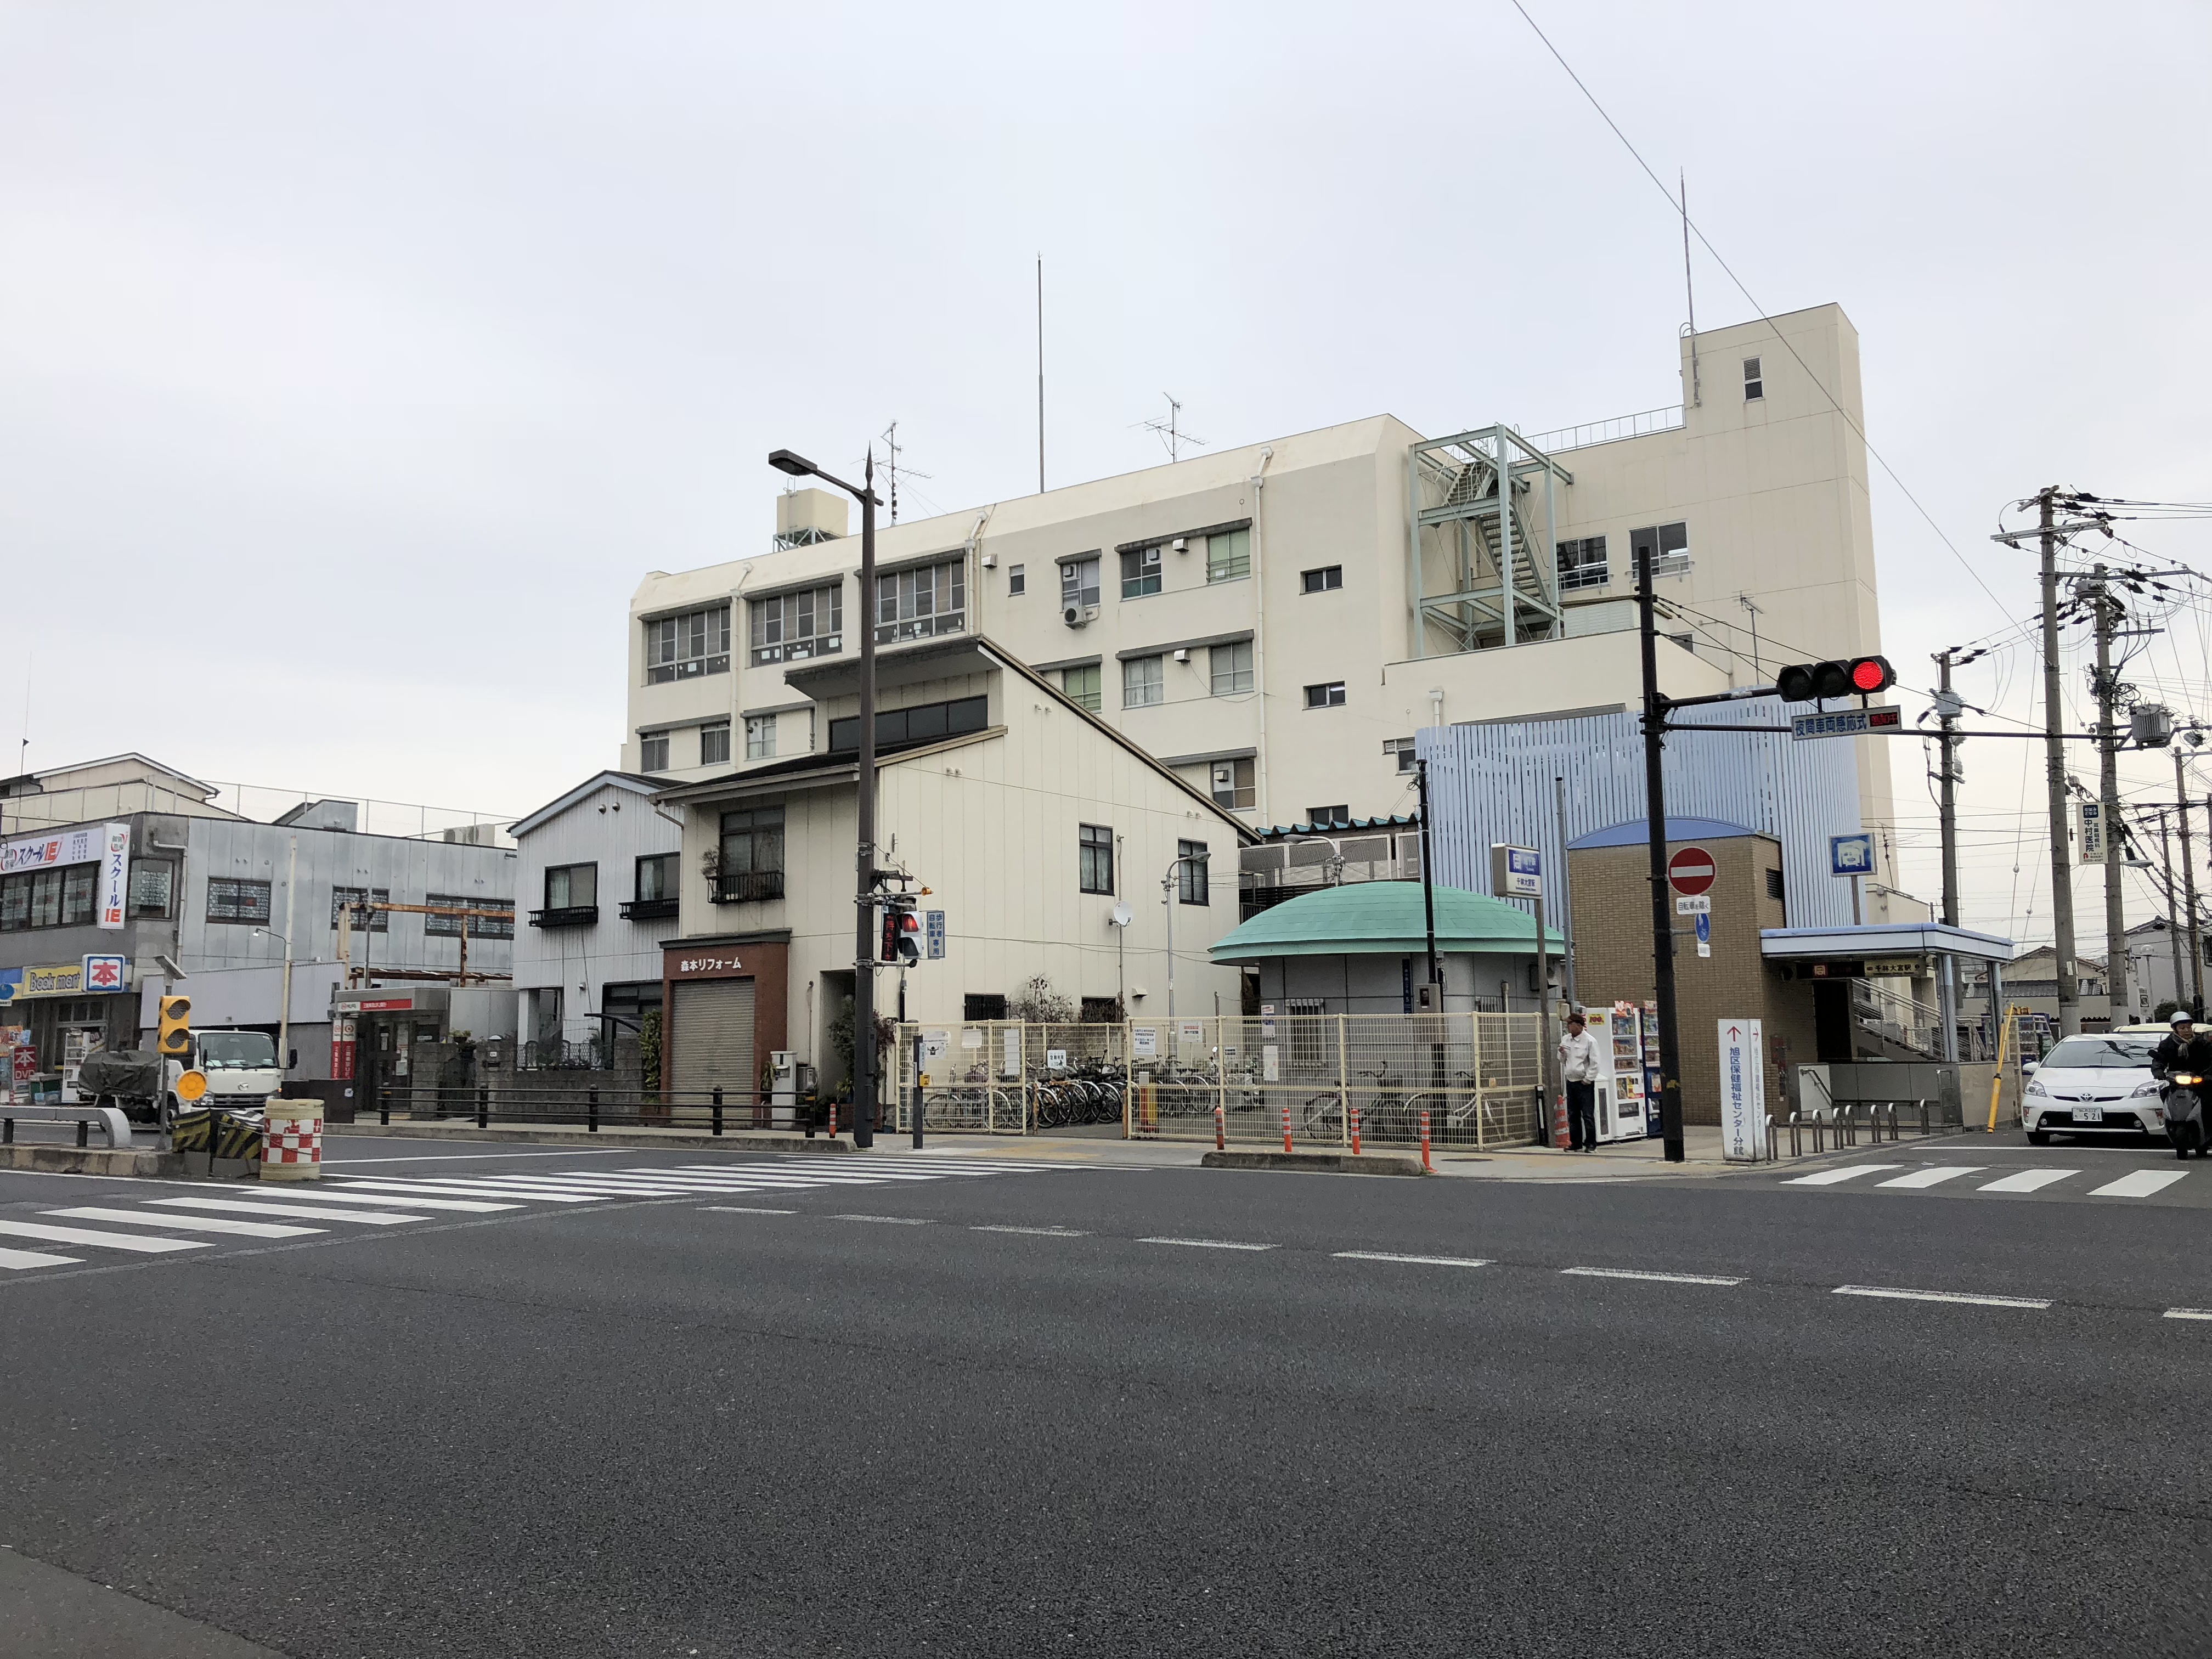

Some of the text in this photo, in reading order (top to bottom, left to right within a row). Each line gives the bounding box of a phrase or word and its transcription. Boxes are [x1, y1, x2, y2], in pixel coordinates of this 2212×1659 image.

[1795, 713, 1867, 736] 夜間車両感応式
[2084, 819, 2094, 852] 中村医院
[1678, 901, 1709, 911] 自転車を除く
[933, 939, 939, 955] 専用
[92, 962, 118, 986] 本
[681, 957, 741, 972] 森本リフォーム
[30, 972, 55, 991] Book
[15, 1049, 36, 1067] 本
[1730, 1047, 1743, 1155] 旭区保健福祉センター分館
